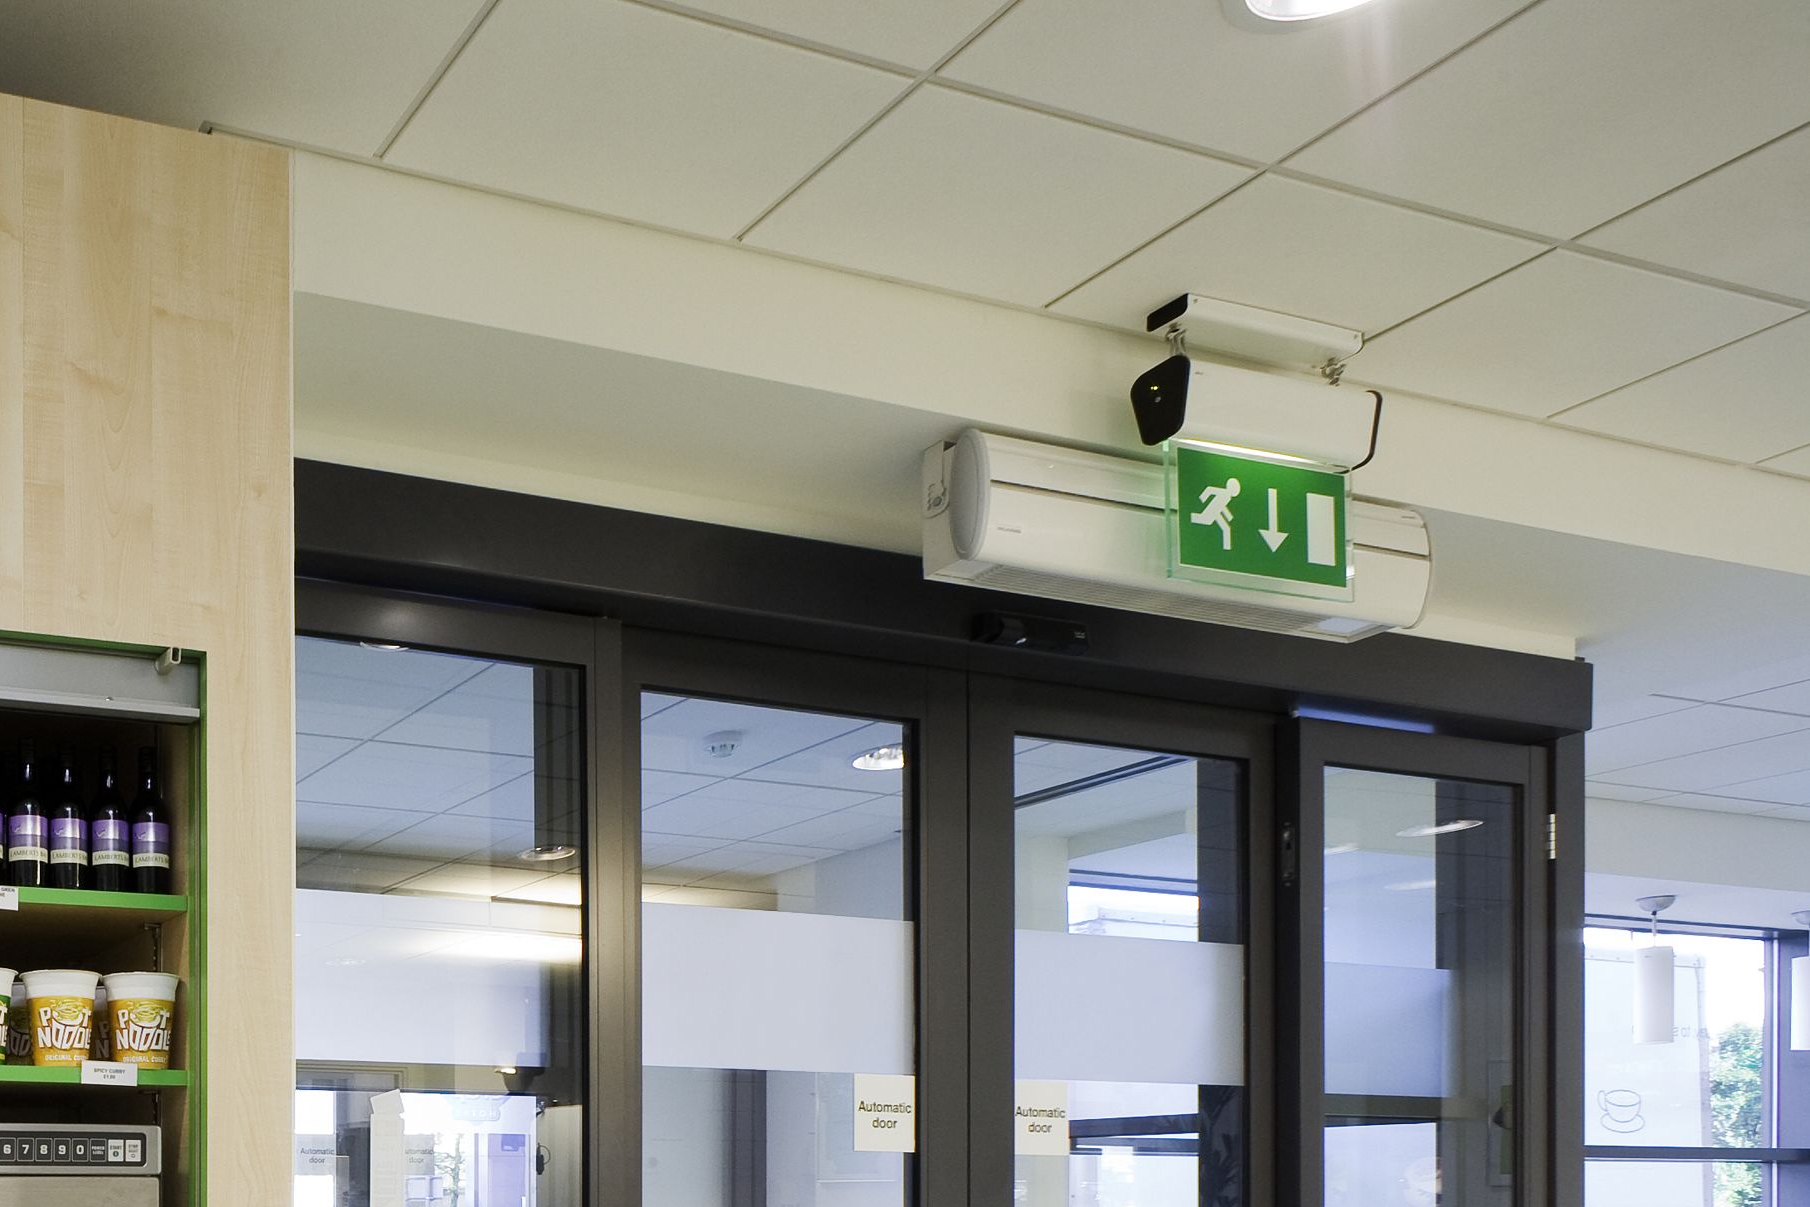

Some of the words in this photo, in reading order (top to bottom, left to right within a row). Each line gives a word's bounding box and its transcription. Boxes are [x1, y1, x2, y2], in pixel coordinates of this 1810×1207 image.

[40, 1007, 91, 1027] POT
[117, 1009, 170, 1028] POT
[37, 1022, 90, 1050] NOODLE
[115, 1023, 171, 1051] NOODLE
[858, 1100, 912, 1115] Automatic
[1015, 1106, 1066, 1119] Automatic
[872, 1117, 897, 1130] door
[1028, 1121, 1053, 1134] door
[3, 1144, 11, 1155] 6
[22, 1145, 30, 1155] 7
[40, 1145, 48, 1155] 8
[58, 1145, 66, 1155] 9
[76, 1145, 84, 1155] 0
[300, 1147, 335, 1155] Automatic
